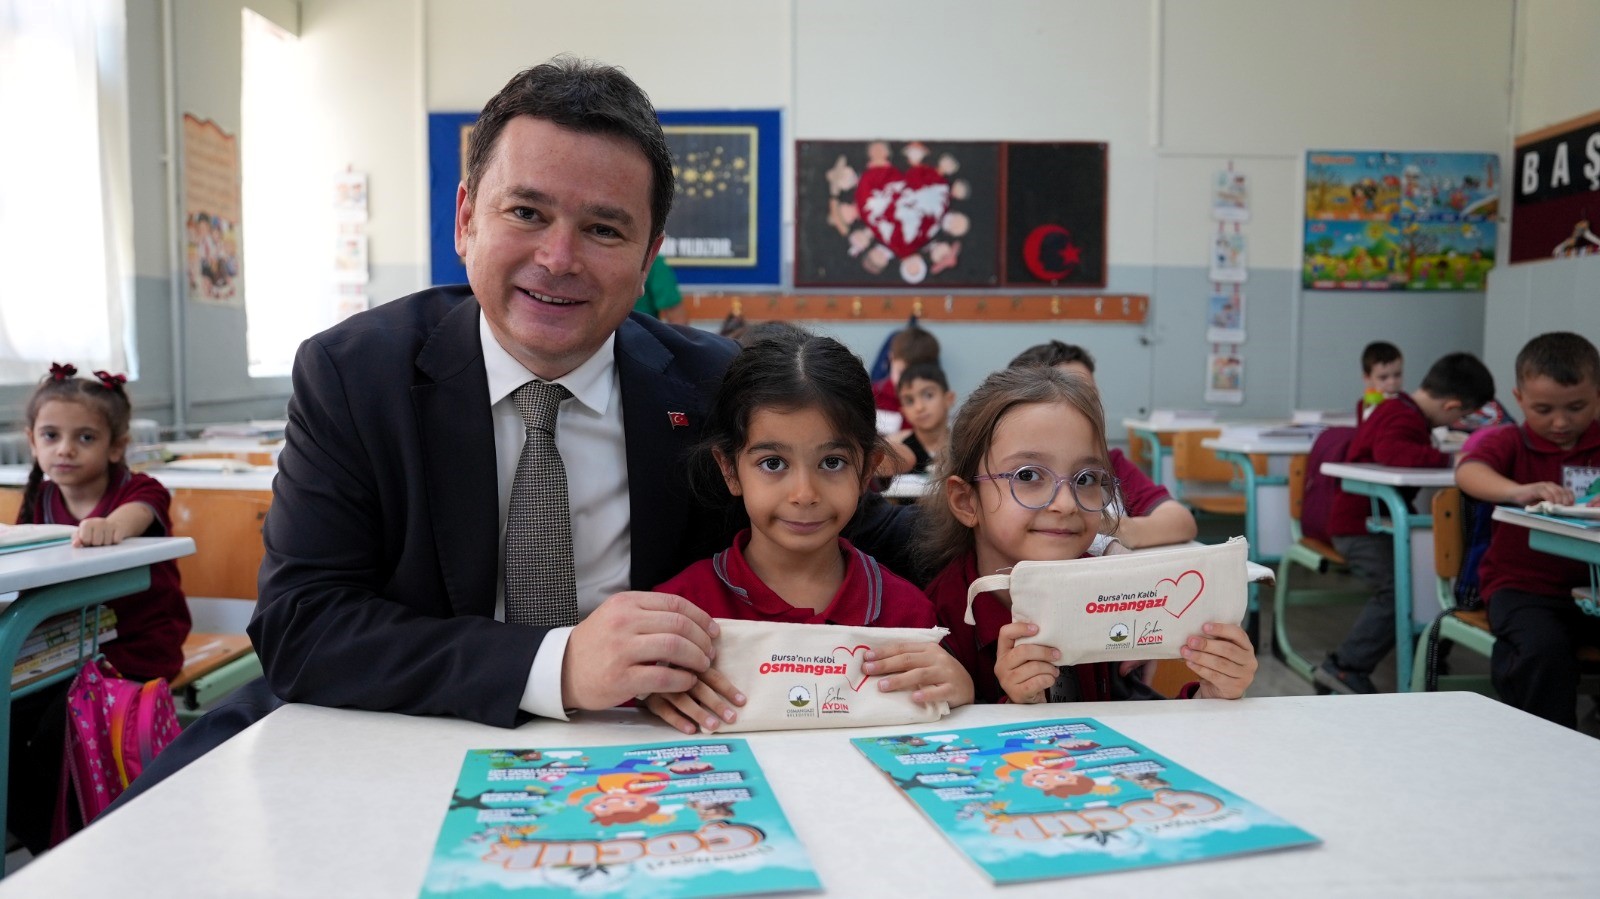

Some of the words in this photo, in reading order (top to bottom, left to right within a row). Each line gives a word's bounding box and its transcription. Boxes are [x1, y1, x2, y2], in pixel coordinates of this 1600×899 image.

[1137, 590, 1158, 599] Kalbi
[1086, 596, 1168, 614] Osmangazi
[1137, 635, 1163, 644] AYDIN
[813, 655, 835, 664] Kalbi
[759, 662, 847, 676] Osmangazi
[822, 703, 849, 711] AYDIN
